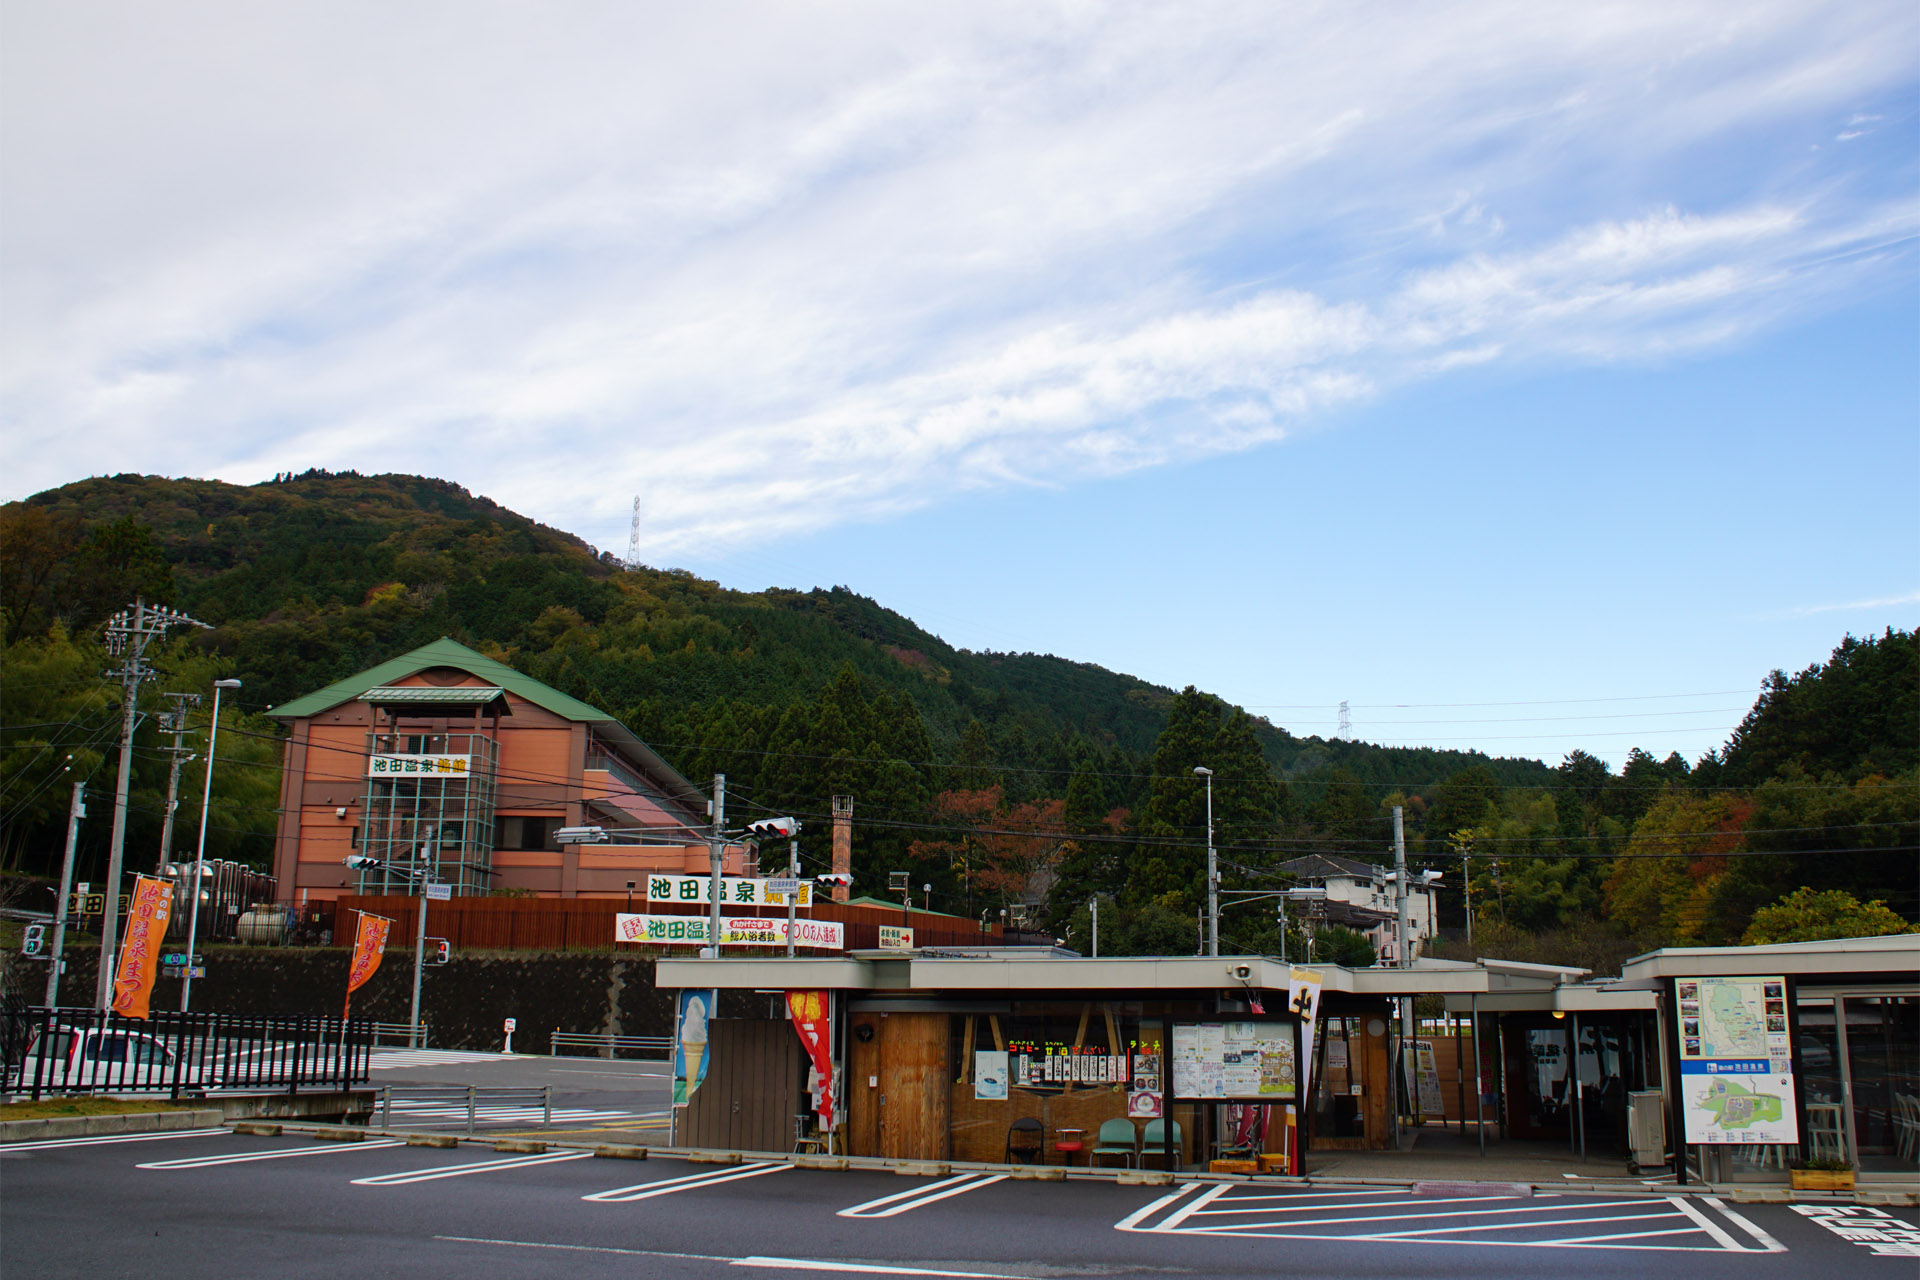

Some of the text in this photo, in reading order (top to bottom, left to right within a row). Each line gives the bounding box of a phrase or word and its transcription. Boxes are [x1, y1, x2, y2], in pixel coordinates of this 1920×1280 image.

[373, 758, 466, 773] 池田温泉新館
[155, 887, 171, 920] 道の駅
[732, 920, 770, 929] おかげさまで
[730, 930, 777, 943] 総入浴者数
[119, 884, 159, 1009] 池田温泉まつり
[1045, 1046, 1068, 1056] 甘酒
[1071, 1045, 1106, 1055] ぜんざい
[1130, 1040, 1161, 1051] ランチ
